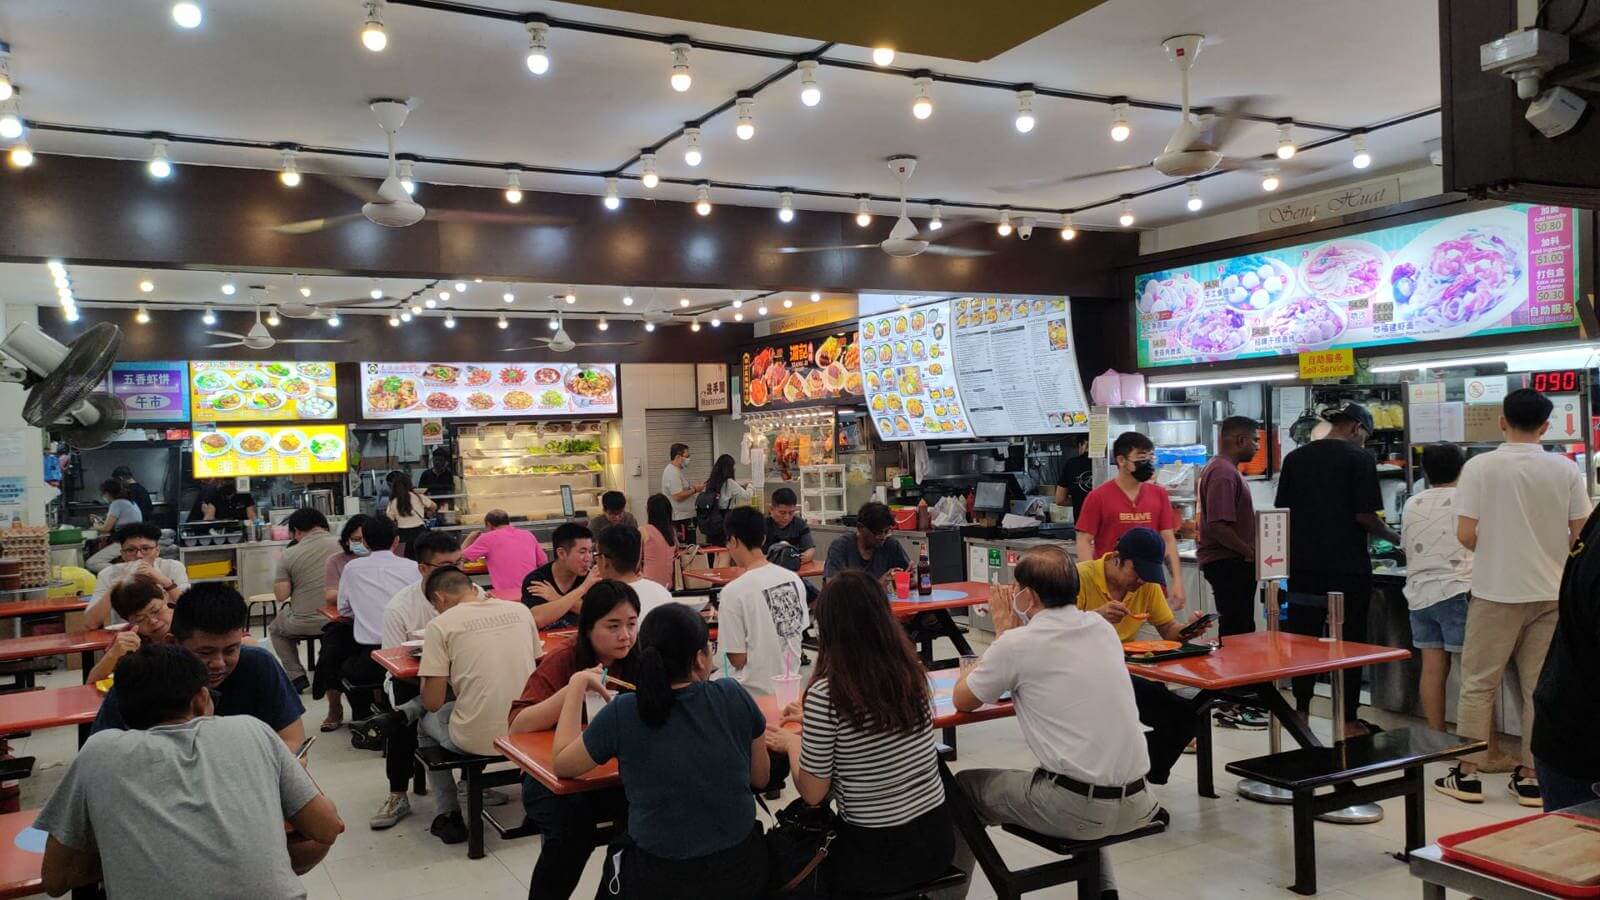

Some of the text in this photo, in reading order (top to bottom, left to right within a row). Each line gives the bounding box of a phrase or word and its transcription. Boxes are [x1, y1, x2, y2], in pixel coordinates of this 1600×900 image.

[1530, 303, 1573, 317] 自助服务
[124, 374, 169, 385] 五香虾饼
[1535, 372, 1576, 392] 090
[136, 396, 161, 408] 午市
